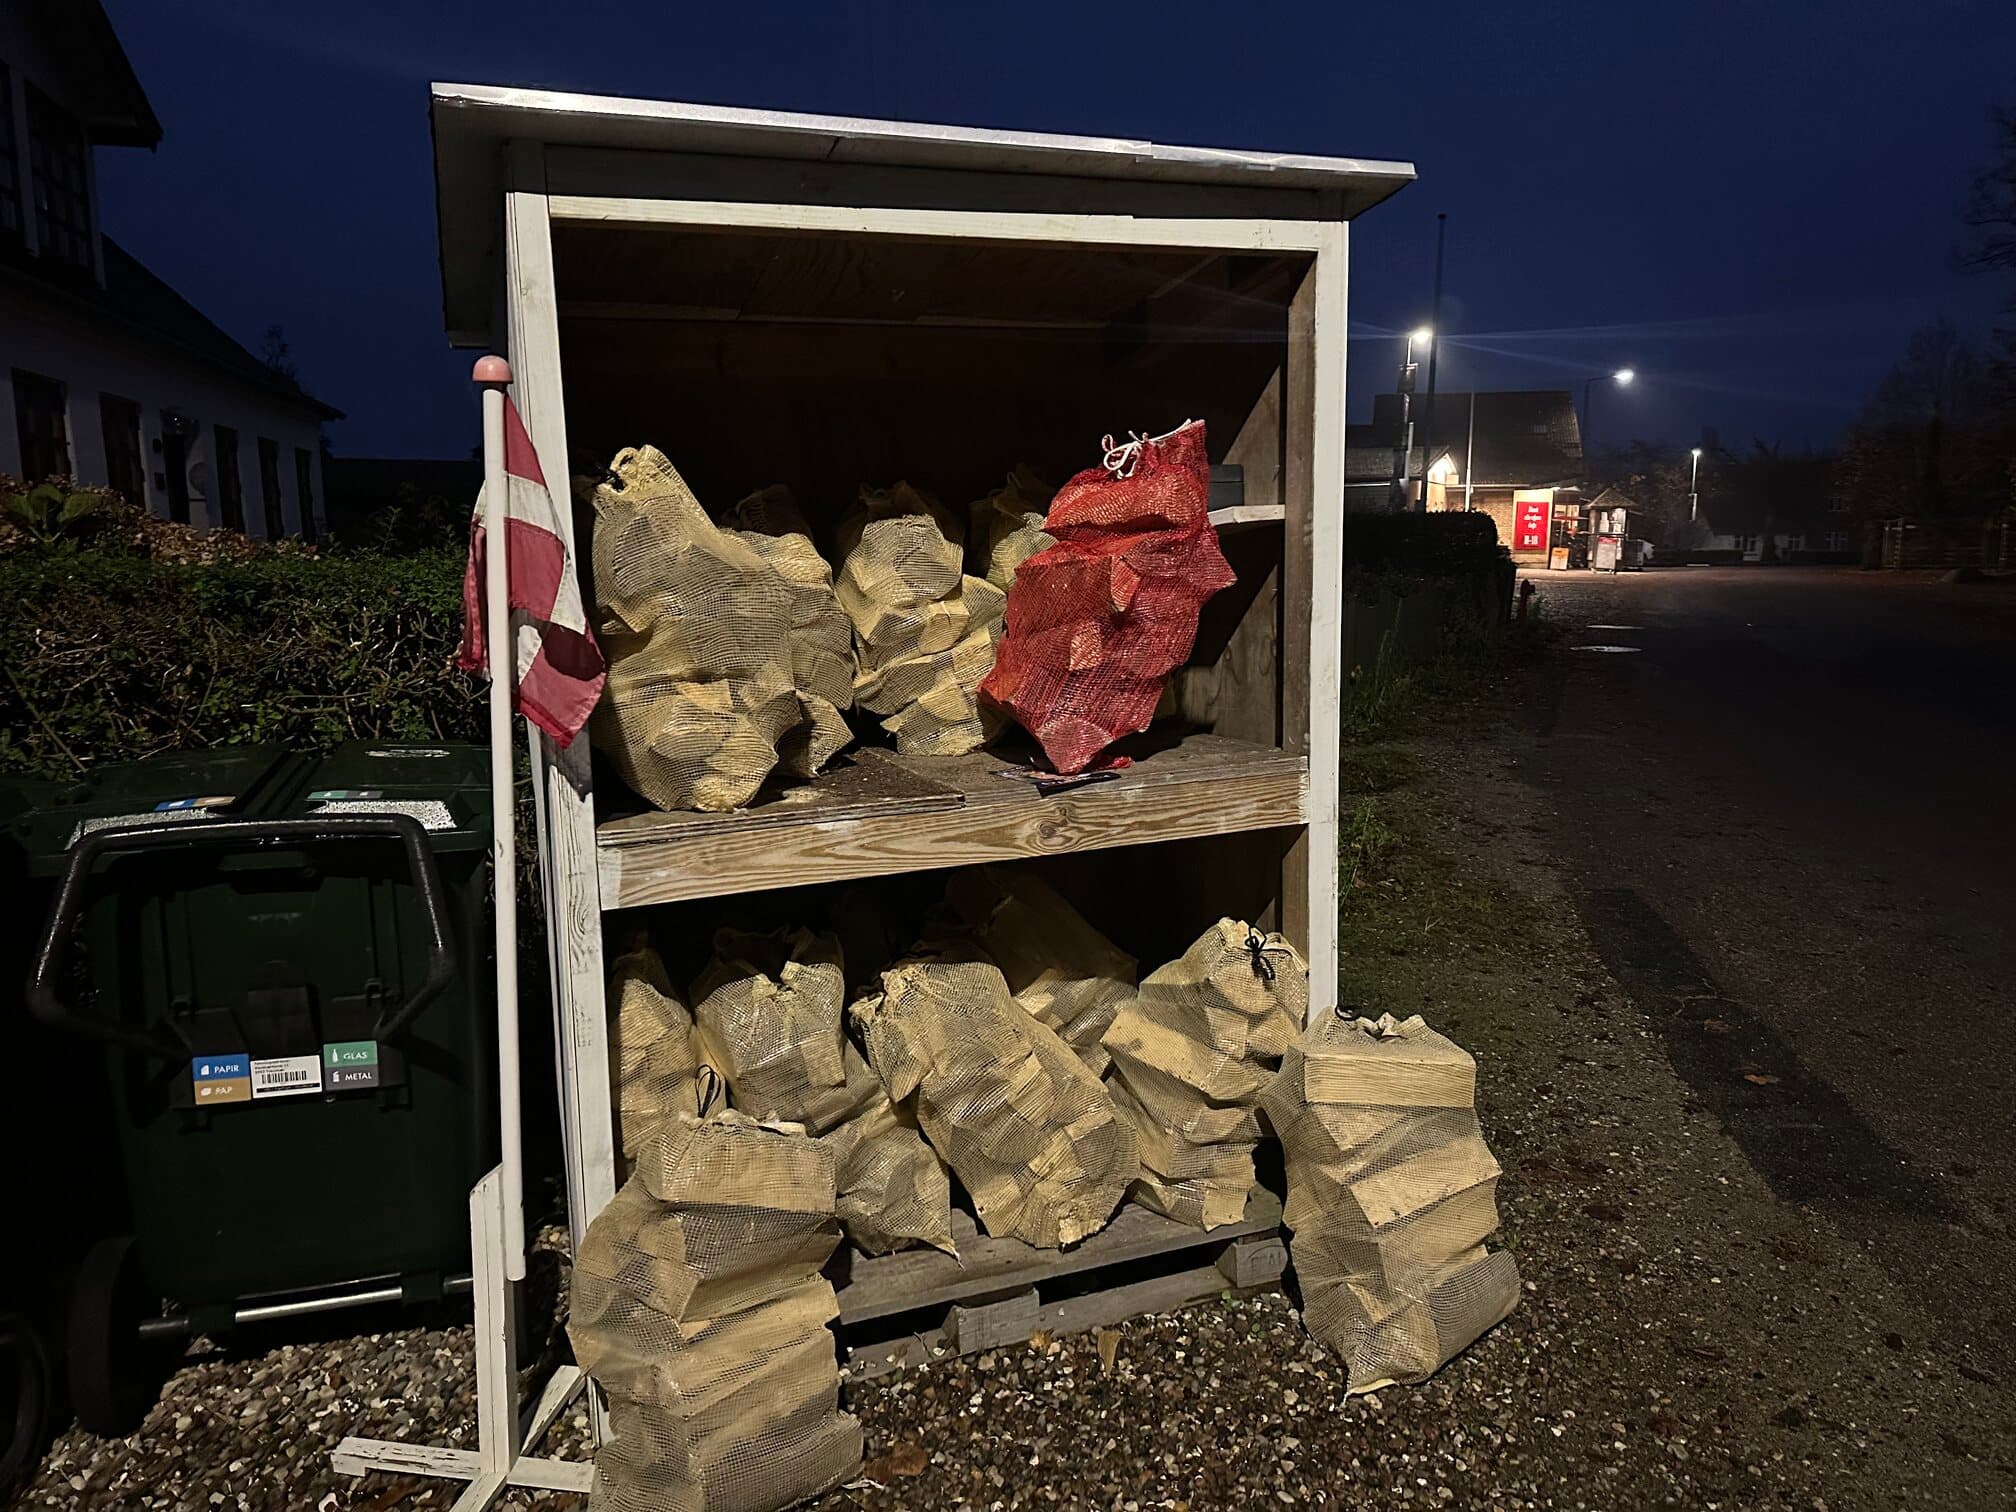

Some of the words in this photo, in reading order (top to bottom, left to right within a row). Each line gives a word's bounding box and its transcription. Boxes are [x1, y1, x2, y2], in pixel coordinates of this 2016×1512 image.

[343, 1051, 368, 1060] GLAS
[214, 1064, 240, 1074] PAPIR
[345, 1071, 373, 1081] METAL
[215, 1086, 233, 1095] PAP
